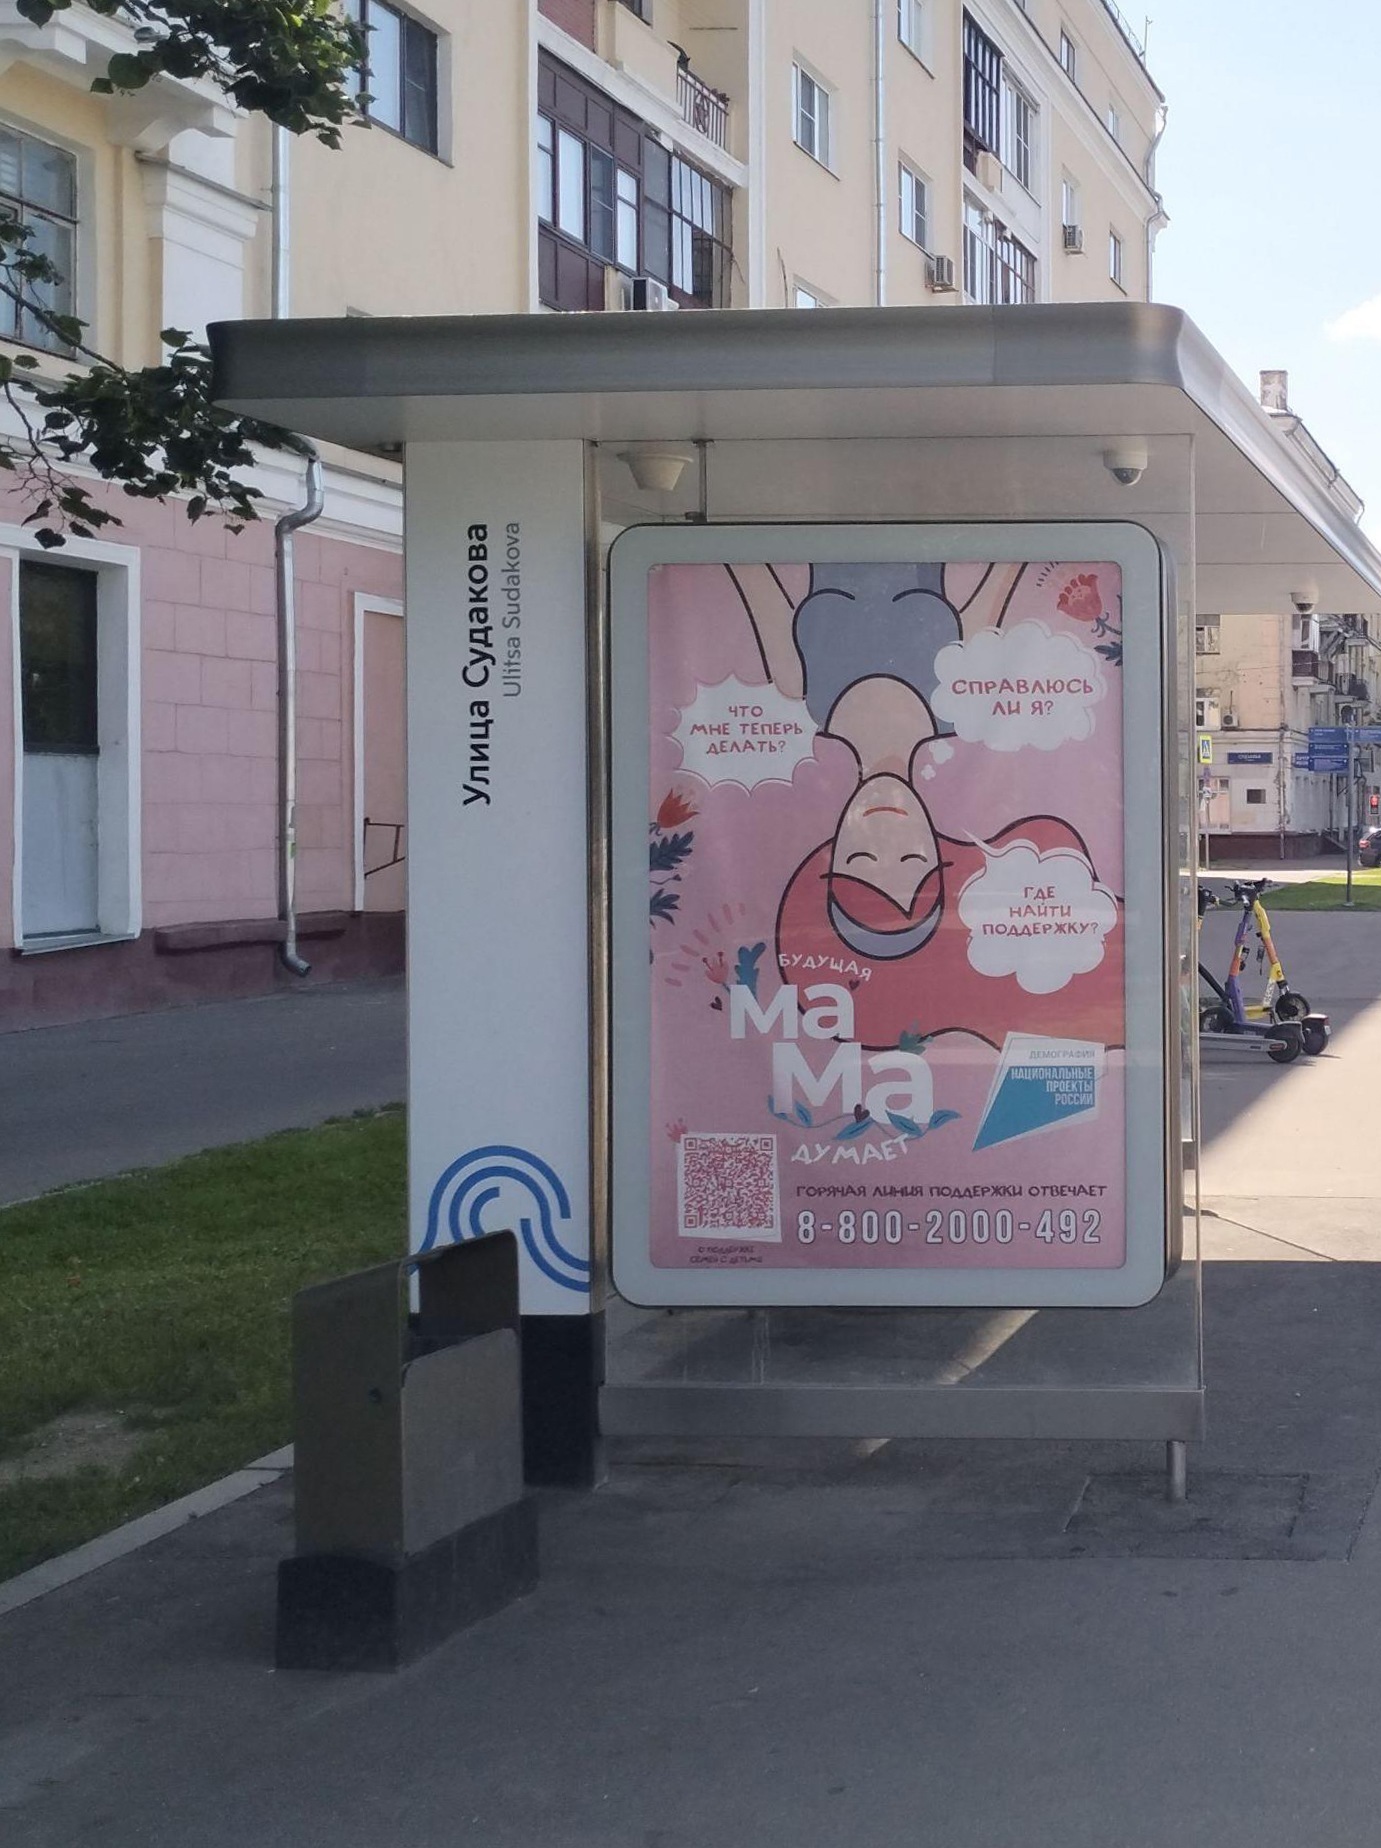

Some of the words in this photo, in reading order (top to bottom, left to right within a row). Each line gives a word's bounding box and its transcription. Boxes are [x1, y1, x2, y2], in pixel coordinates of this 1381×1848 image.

[501, 522, 521, 629] Sudakova
[461, 523, 496, 688] Судакова
[502, 636, 522, 698] Ulitsa
[951, 678, 1094, 695] СПРАВЛЮСЬ
[728, 705, 763, 717] ЧТО
[991, 700, 1021, 715] ЛИ
[1030, 700, 1054, 715] Я?
[690, 723, 730, 735] МНЕ
[739, 722, 803, 735] ТЕПЕРЬ
[462, 700, 494, 806] Улица
[706, 740, 786, 754] ДЕЛАТЬ?
[1024, 886, 1056, 900] ГДЕ
[1009, 902, 1071, 918] НАЙТИ
[982, 922, 1099, 937] ПОДДЕРЖКУ?
[778, 953, 872, 981] БУДУЩАЯ
[1029, 1049, 1096, 1059] ДЕМОГРАФИЯ
[1011, 1067, 1094, 1080] НАЦИОНАЛЬНЫЕ
[1046, 1080, 1094, 1092] ПРОЕКТЫ
[1055, 1093, 1094, 1105] РОССИИ
[791, 1133, 912, 1165] ДУМАЕТ
[796, 1185, 867, 1197] ГОРЯЧАЯ
[872, 1185, 924, 1197] ЛИНИЯ
[929, 1185, 1023, 1198] ПОДДЕРЖКИ
[1028, 1184, 1108, 1197] ОТВЕЧАЕТ
[797, 1209, 1101, 1244] 8-800-2000-492
